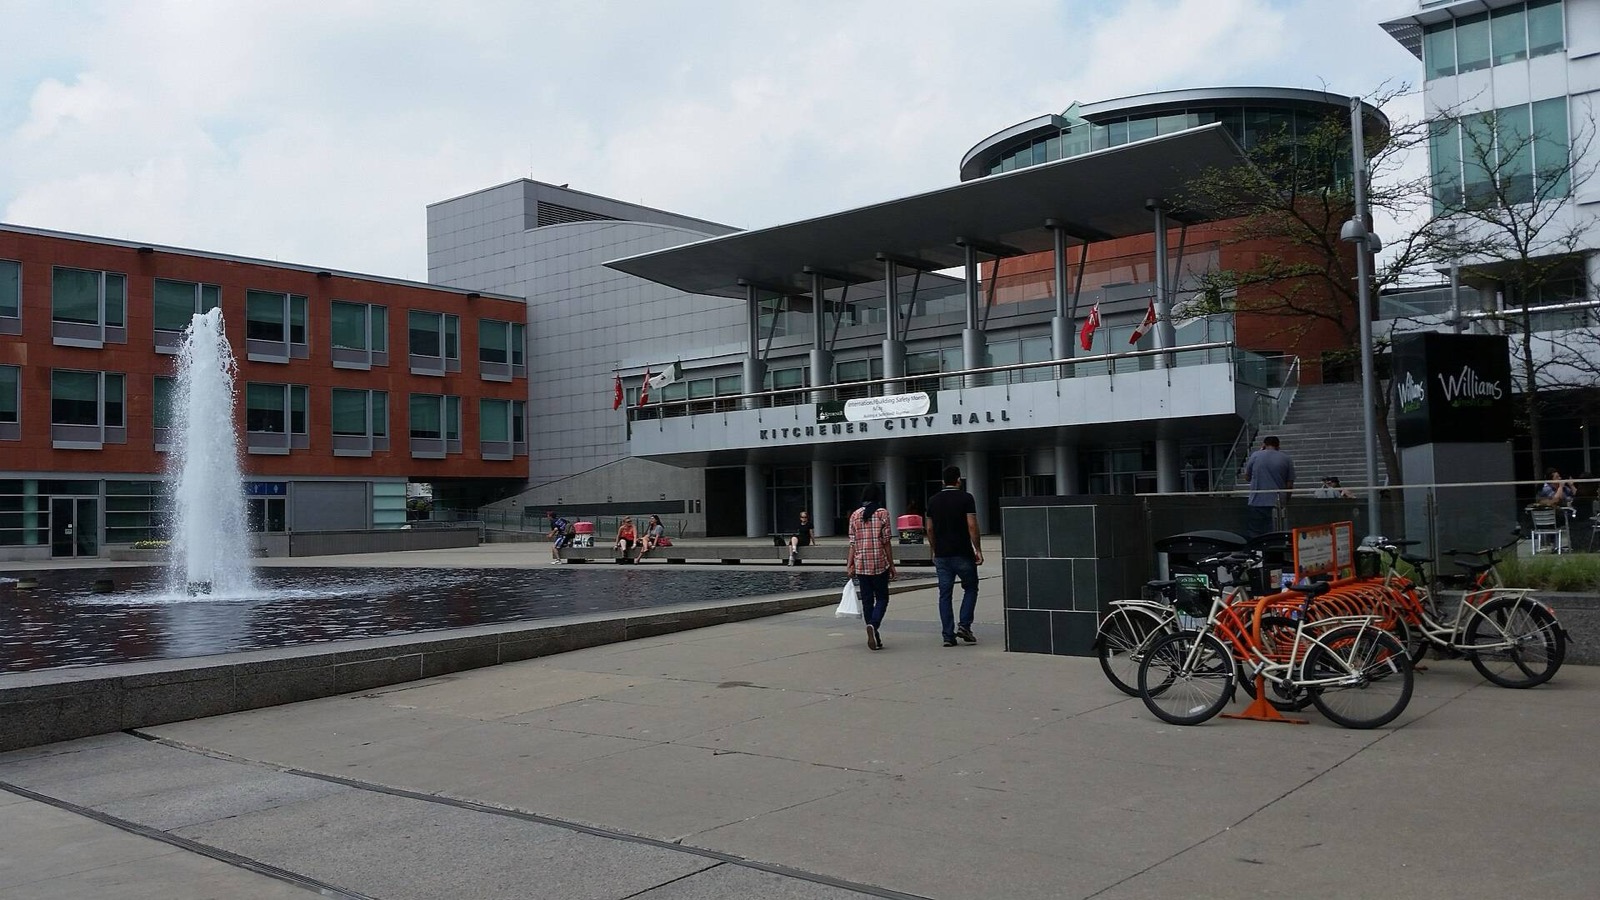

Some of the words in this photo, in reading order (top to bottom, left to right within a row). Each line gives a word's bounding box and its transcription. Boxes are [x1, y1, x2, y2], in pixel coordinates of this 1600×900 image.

[1438, 365, 1502, 401] Williams
[760, 421, 868, 440] KITCHENER
[884, 416, 935, 430] CITY
[952, 409, 1010, 425] HALL
